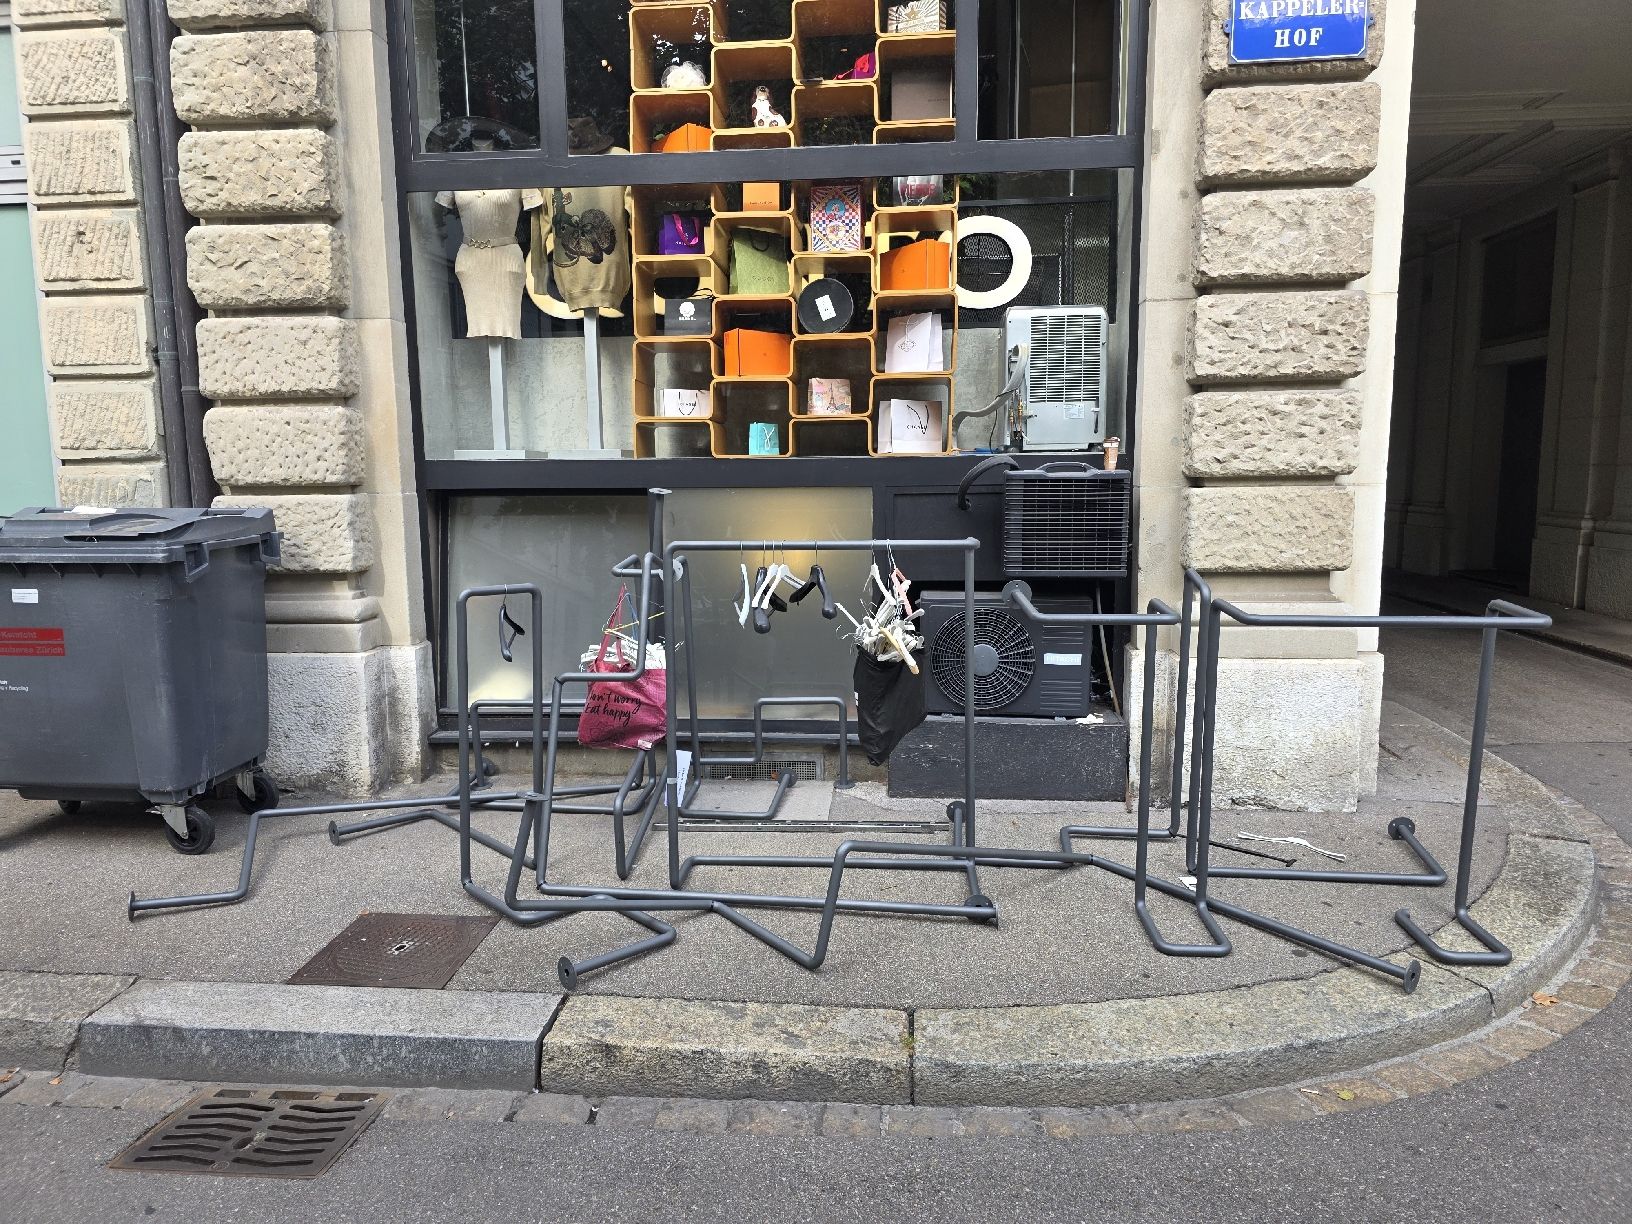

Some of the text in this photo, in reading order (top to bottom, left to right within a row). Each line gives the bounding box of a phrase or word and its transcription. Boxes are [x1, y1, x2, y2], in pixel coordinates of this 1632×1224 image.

[1274, 27, 1323, 48] HOF
[602, 702, 631, 728] happy
[613, 694, 642, 715] worry
